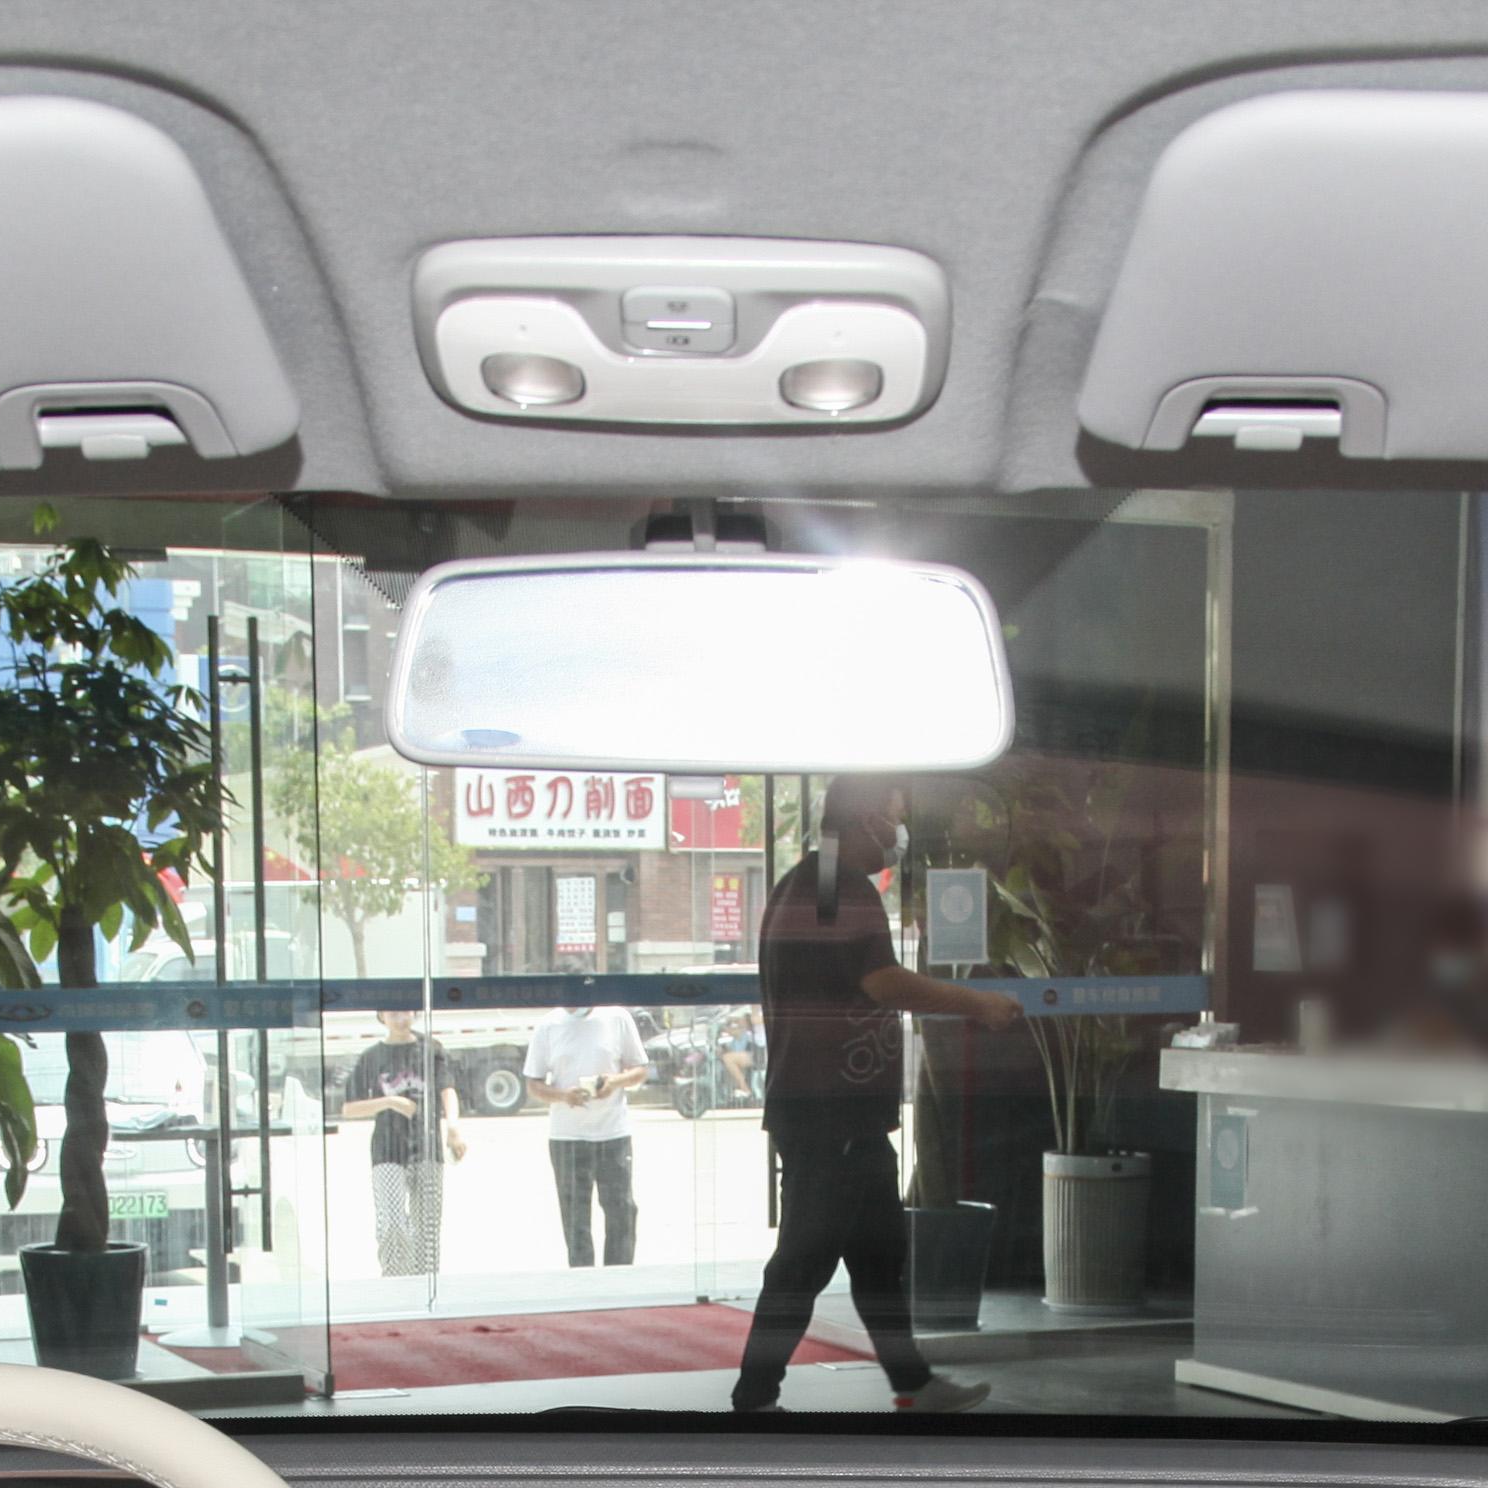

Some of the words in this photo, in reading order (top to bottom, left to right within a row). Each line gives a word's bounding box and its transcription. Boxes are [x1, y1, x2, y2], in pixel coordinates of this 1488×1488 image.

[465, 774, 656, 822] 山西刀削面
